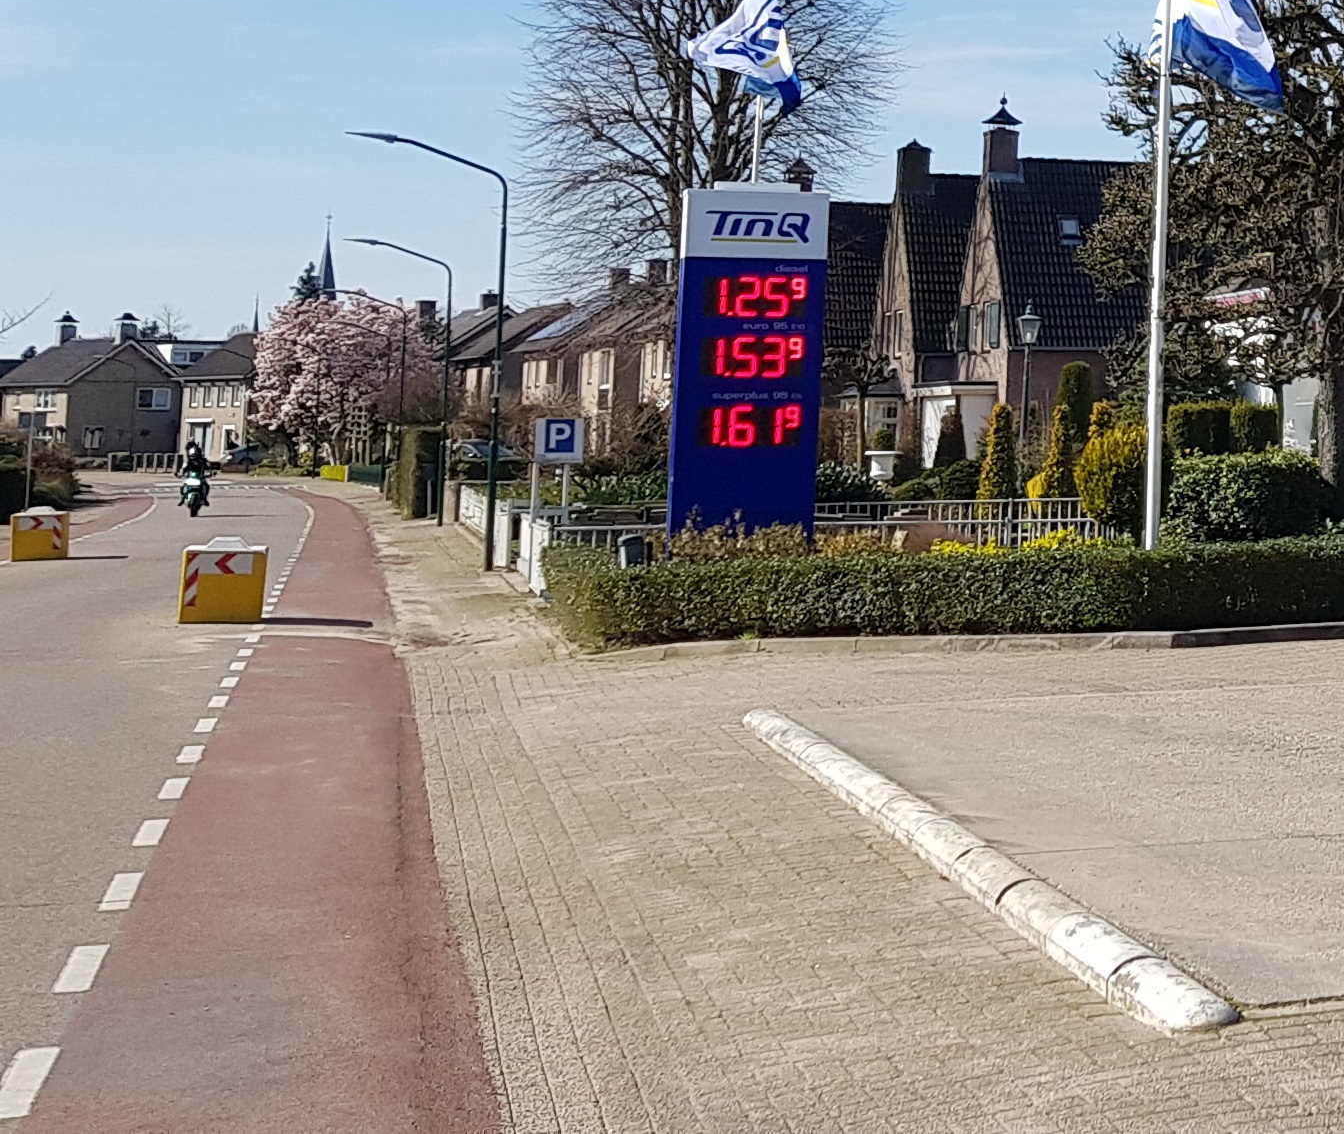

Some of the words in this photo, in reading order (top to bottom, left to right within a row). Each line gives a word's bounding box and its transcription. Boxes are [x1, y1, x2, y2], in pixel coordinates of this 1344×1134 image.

[775, 264, 809, 273] diesel
[773, 321, 788, 330] 95
[712, 391, 769, 401] superplus
[548, 423, 572, 449] P
